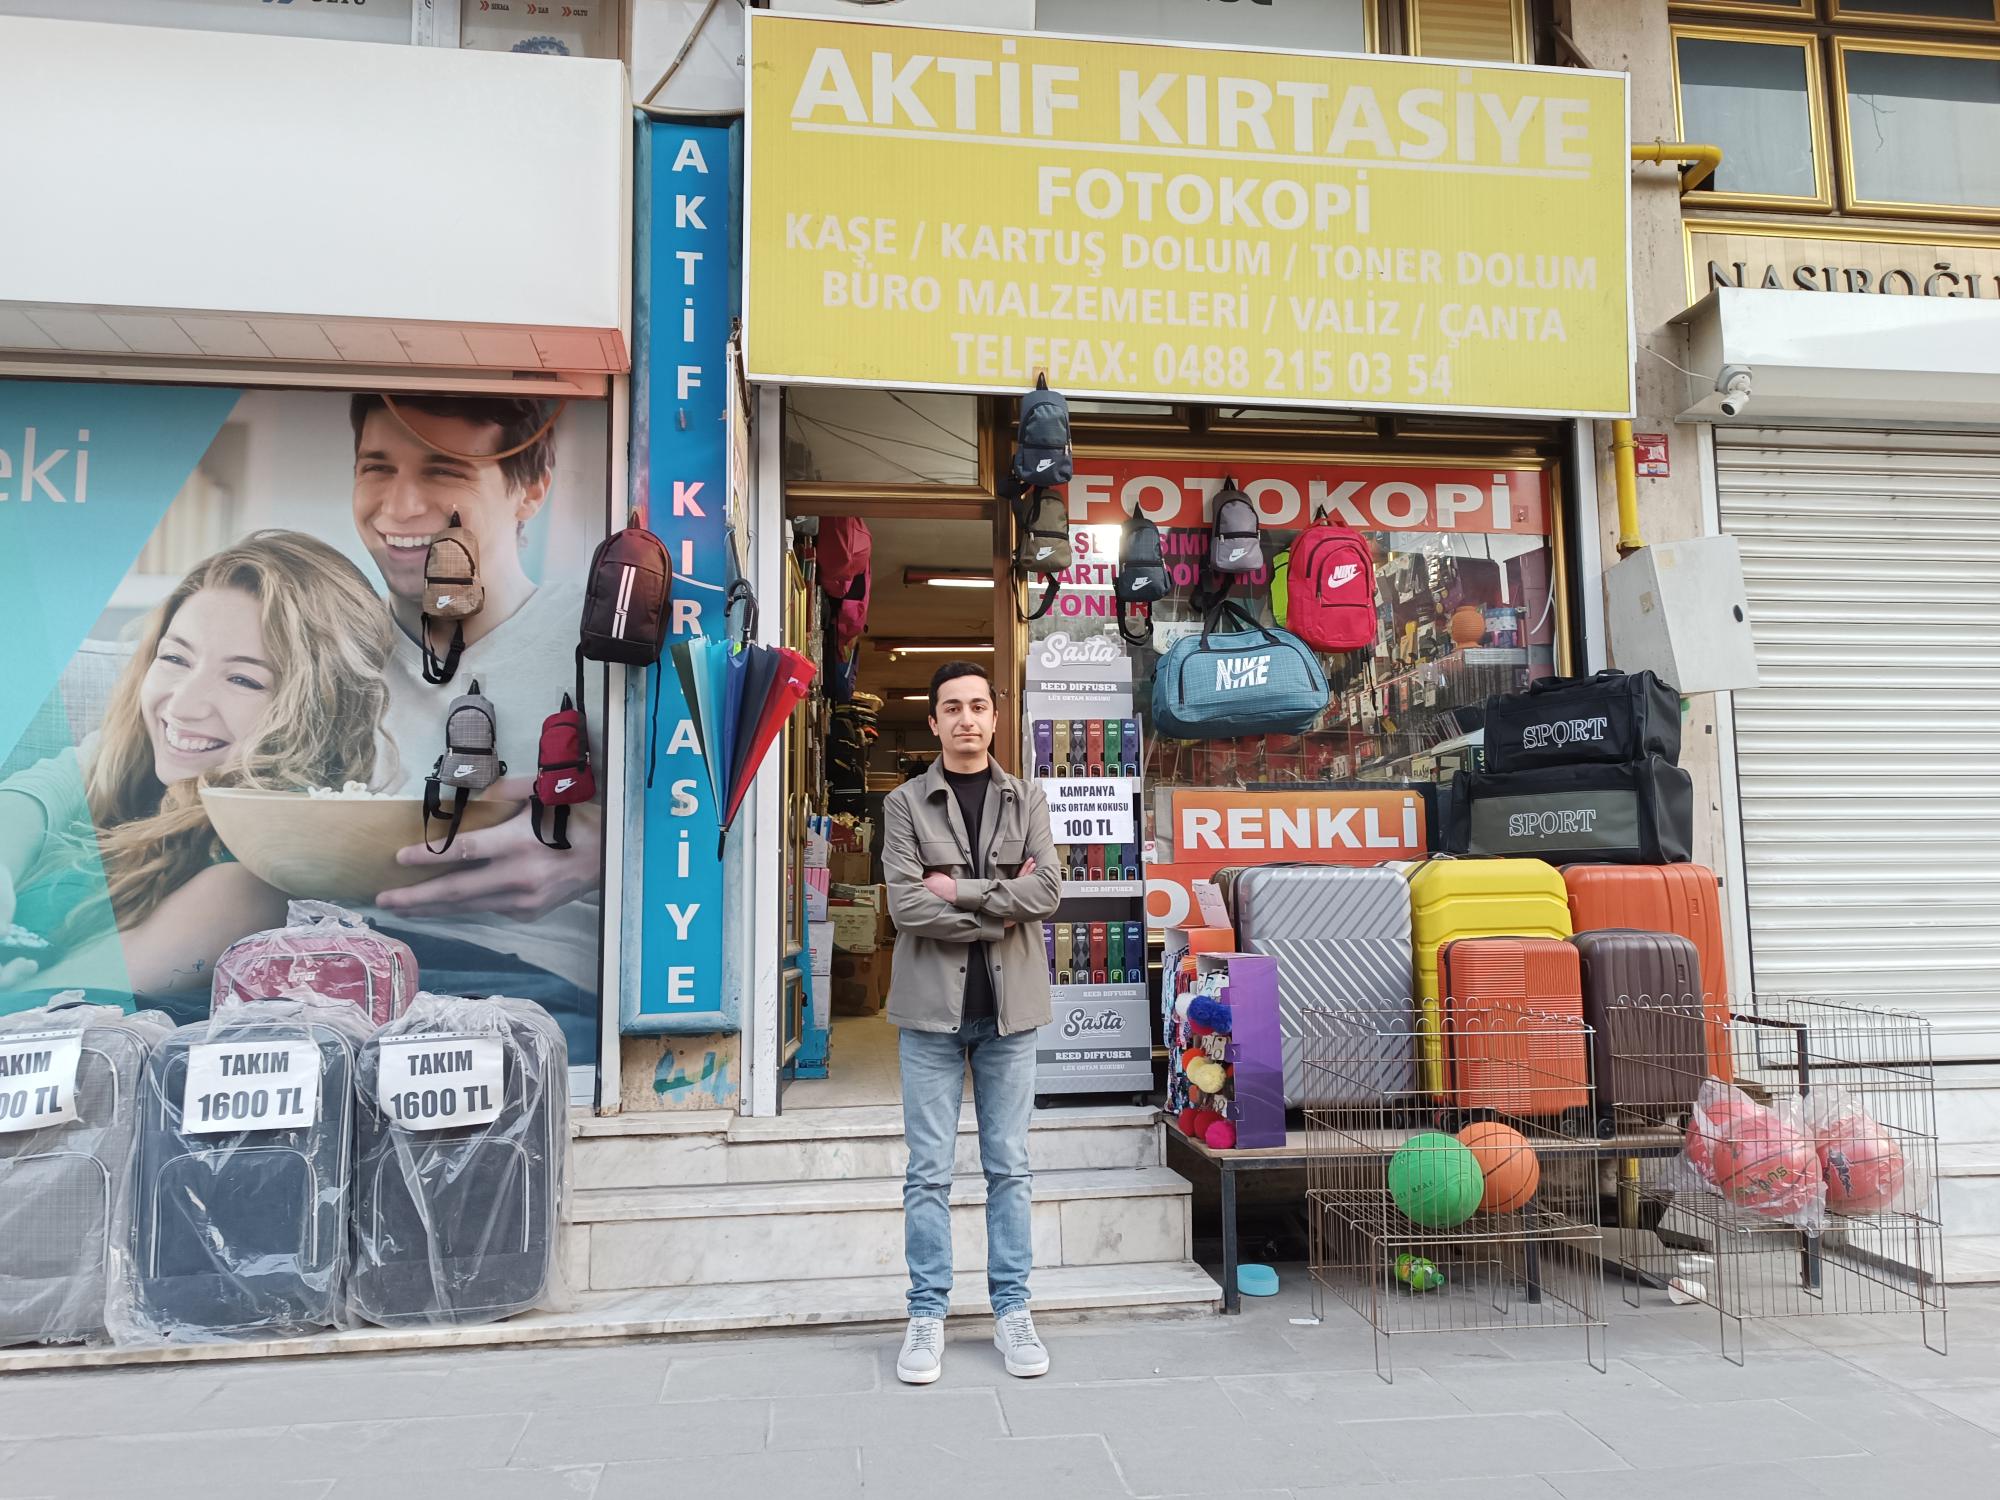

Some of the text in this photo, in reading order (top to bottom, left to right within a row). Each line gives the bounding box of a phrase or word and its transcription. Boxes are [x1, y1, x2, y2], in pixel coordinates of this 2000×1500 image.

[790, 40, 1592, 168] AKTİF KIRTASİYE
[1037, 165, 1371, 234] FOTOKOPİ
[786, 212, 897, 269] KAŞE
[941, 223, 1106, 277] KARTUŞ
[1122, 233, 1270, 276] DOLUM
[1310, 243, 1443, 284] TONER
[1457, 252, 1597, 290] DOLUM
[671, 139, 709, 400] AKTİF
[823, 264, 942, 313] BÜRO
[958, 279, 1249, 329] MALZEMELERİ
[1289, 290, 1400, 336] VALİZ
[1440, 303, 1568, 348] ÇANTA
[1153, 344, 1250, 388] 0488
[1264, 348, 1334, 392] 215
[1348, 352, 1393, 395] 03
[1408, 355, 1453, 397] 54
[1068, 473, 1512, 530] FOTOKOPİ
[1333, 563, 1358, 580] NIKE
[1040, 633, 1117, 668] Sasta
[1041, 682, 1118, 692] REED DIFFUSER
[1215, 655, 1271, 692] NIKE
[665, 481, 705, 1004] KIRASİYE
[1523, 717, 1608, 749] SPORT
[1060, 785, 1115, 798] KAMPANYA
[1068, 803, 1096, 812] ORTAM
[1097, 802, 1129, 812] KOKUSU
[1063, 819, 1113, 836] 100 TL
[1182, 797, 1418, 849] RENKLİ
[1508, 809, 1596, 837] SPORT
[1062, 1008, 1124, 1038] Sasta
[0, 1050, 52, 1077] AKIM
[220, 1051, 289, 1077] TAKIM
[407, 1050, 473, 1076] TAKIM
[1055, 1050, 1132, 1061] REED DIFFUSER
[35, 1085, 62, 1115] TL
[198, 1087, 304, 1121] 1600 TL
[390, 1085, 493, 1120] 1600 TL
